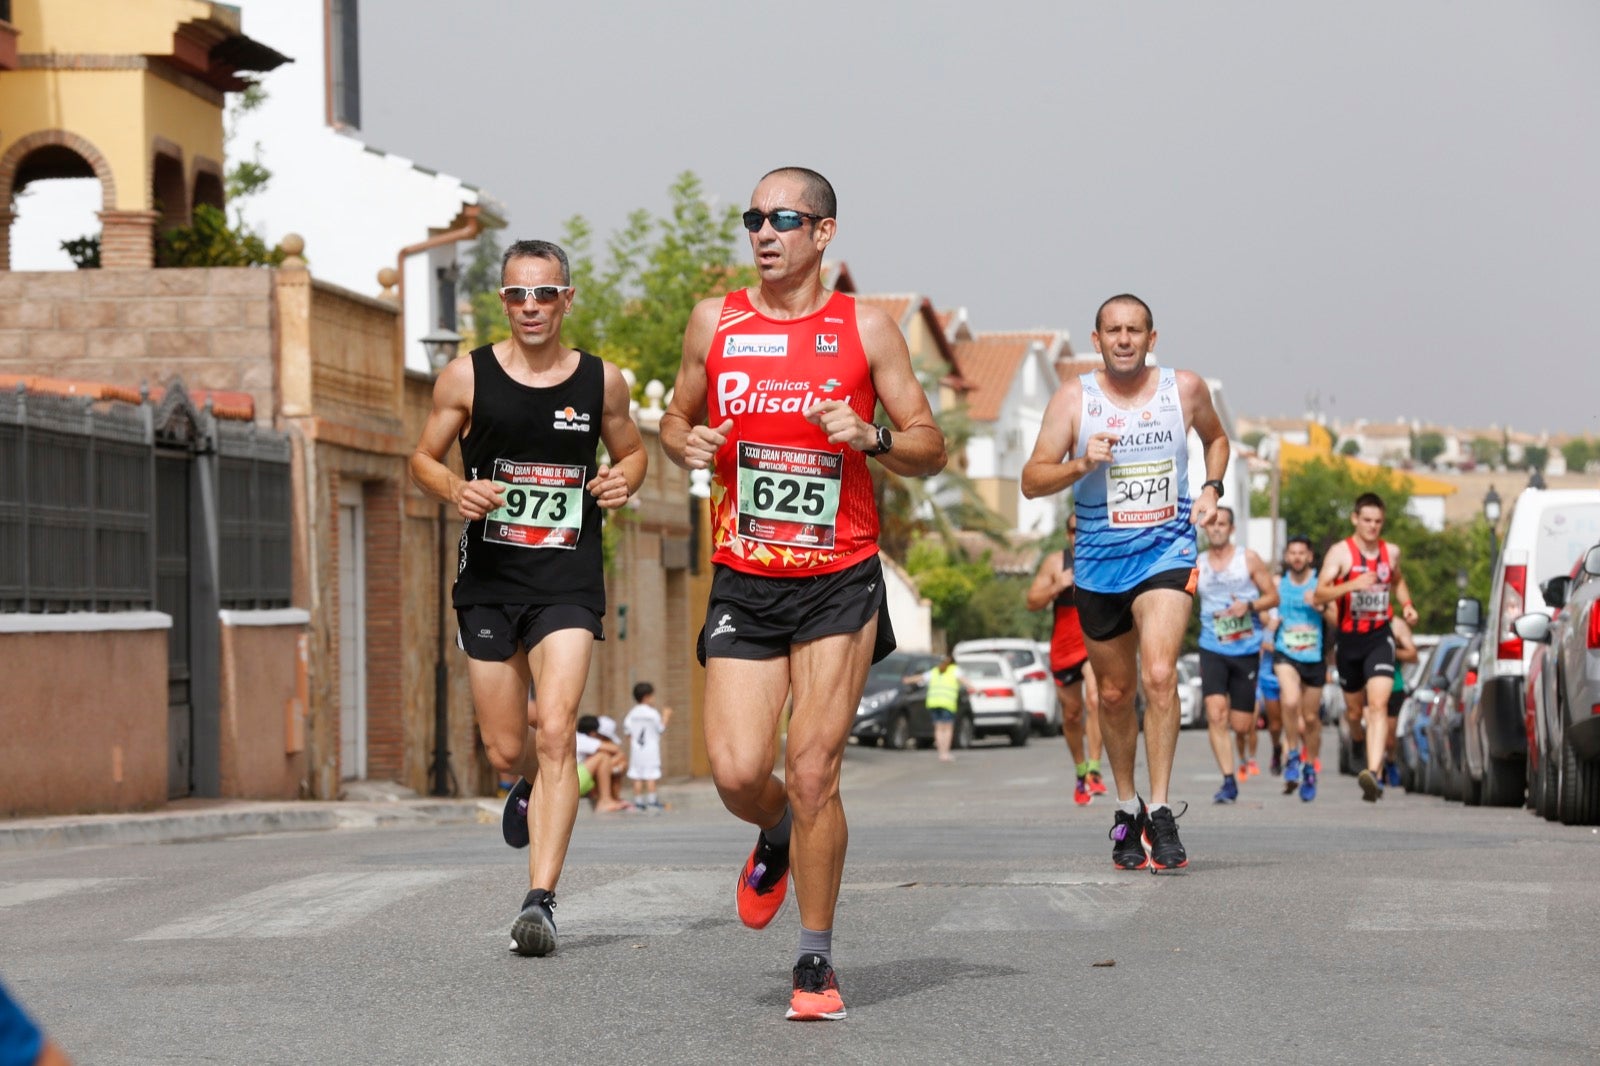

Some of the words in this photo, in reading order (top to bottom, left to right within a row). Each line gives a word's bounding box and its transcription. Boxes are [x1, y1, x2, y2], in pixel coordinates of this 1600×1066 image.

[818, 335, 822, 345] I
[717, 371, 851, 417] Polisal
[756, 379, 810, 391] Clínicas
[1115, 430, 1173, 447] RACENA
[745, 446, 760, 459] XXXII
[761, 448, 780, 461] GRAN
[781, 451, 806, 464] PREMIO
[808, 454, 817, 465] DE
[817, 455, 837, 468] FONDO
[514, 464, 531, 476] GRAN
[531, 465, 554, 477] PREMIO
[555, 467, 562, 478] DE
[562, 467, 580, 479] FONDO
[753, 476, 826, 516] 625
[1115, 476, 1170, 505] 3079
[506, 489, 567, 521] 973
[1117, 509, 1165, 522] Cruzcampo
